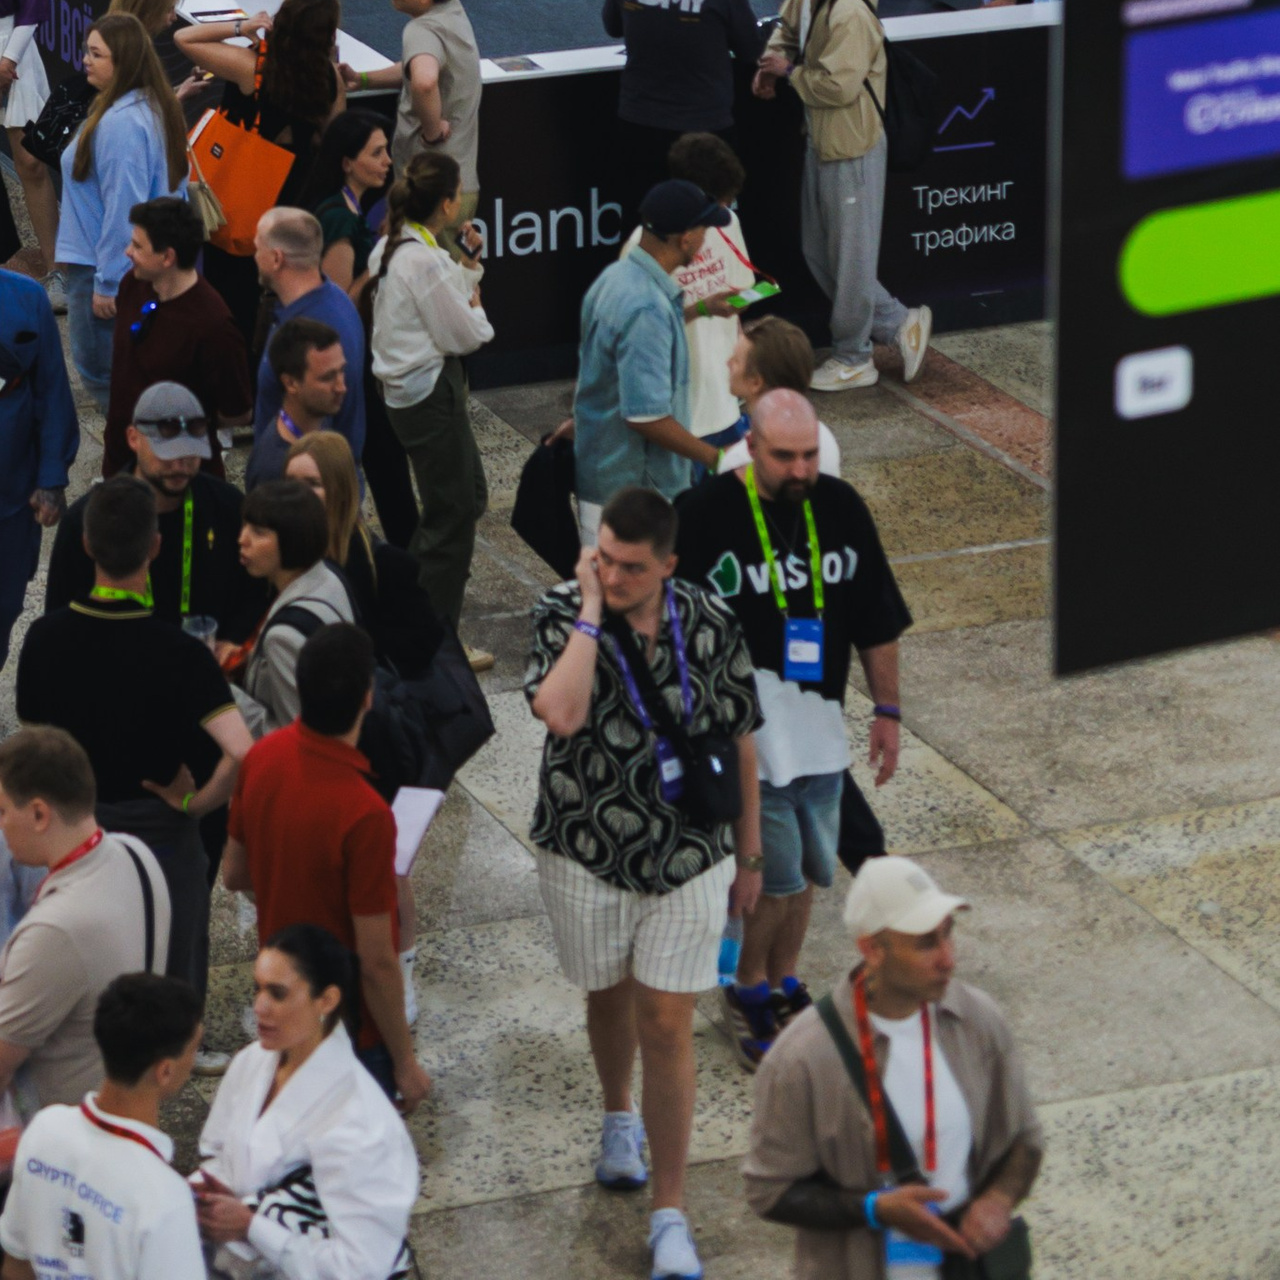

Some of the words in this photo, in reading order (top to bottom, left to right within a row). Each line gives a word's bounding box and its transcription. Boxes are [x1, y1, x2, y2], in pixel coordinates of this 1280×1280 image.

[913, 180, 1014, 214] Трекинг
[472, 187, 622, 260] alanb
[911, 218, 1016, 256] трафика
